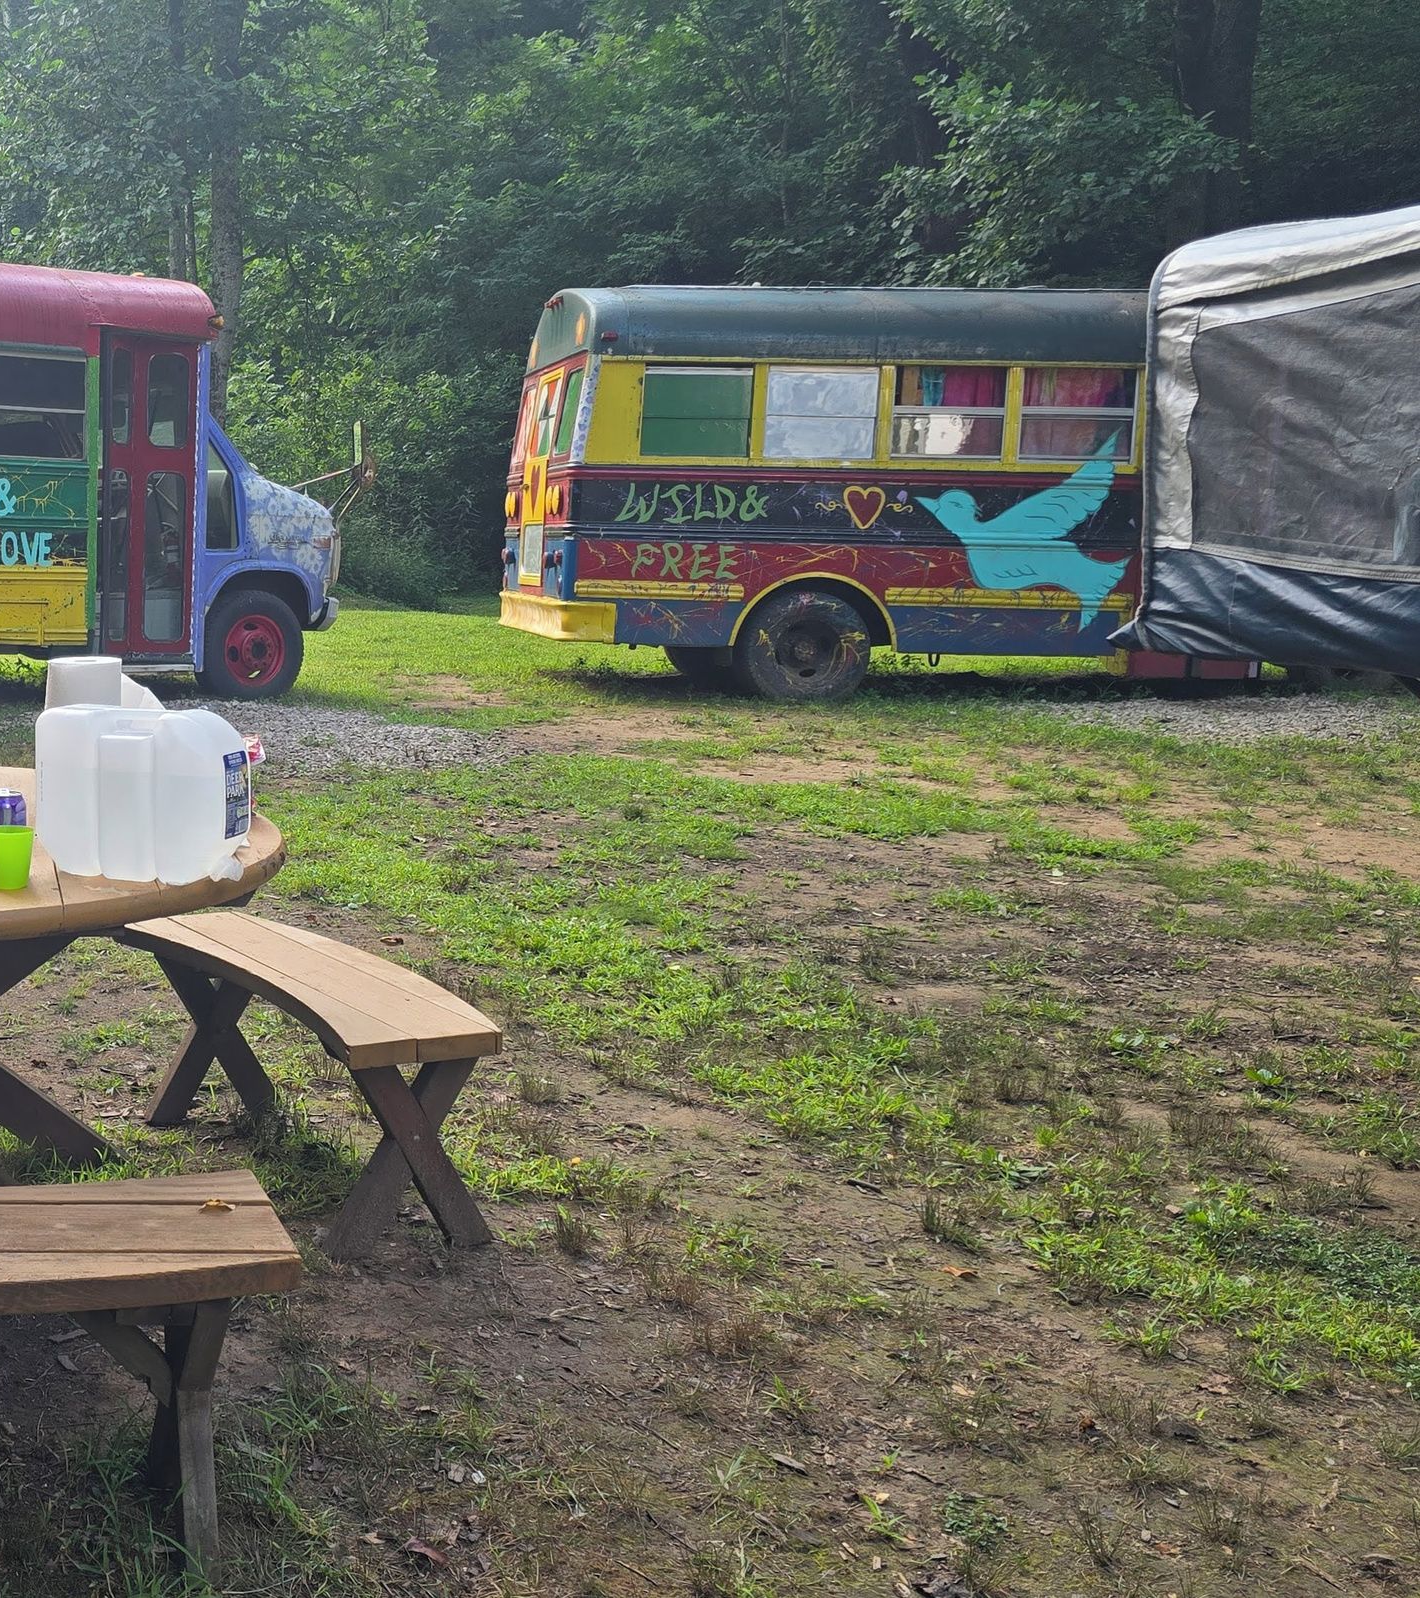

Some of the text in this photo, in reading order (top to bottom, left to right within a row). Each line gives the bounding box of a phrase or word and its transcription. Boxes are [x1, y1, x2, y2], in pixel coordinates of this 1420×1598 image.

[631, 542, 740, 580] FREE
[226, 770, 244, 786] DEER
[226, 783, 245, 799] PARK
